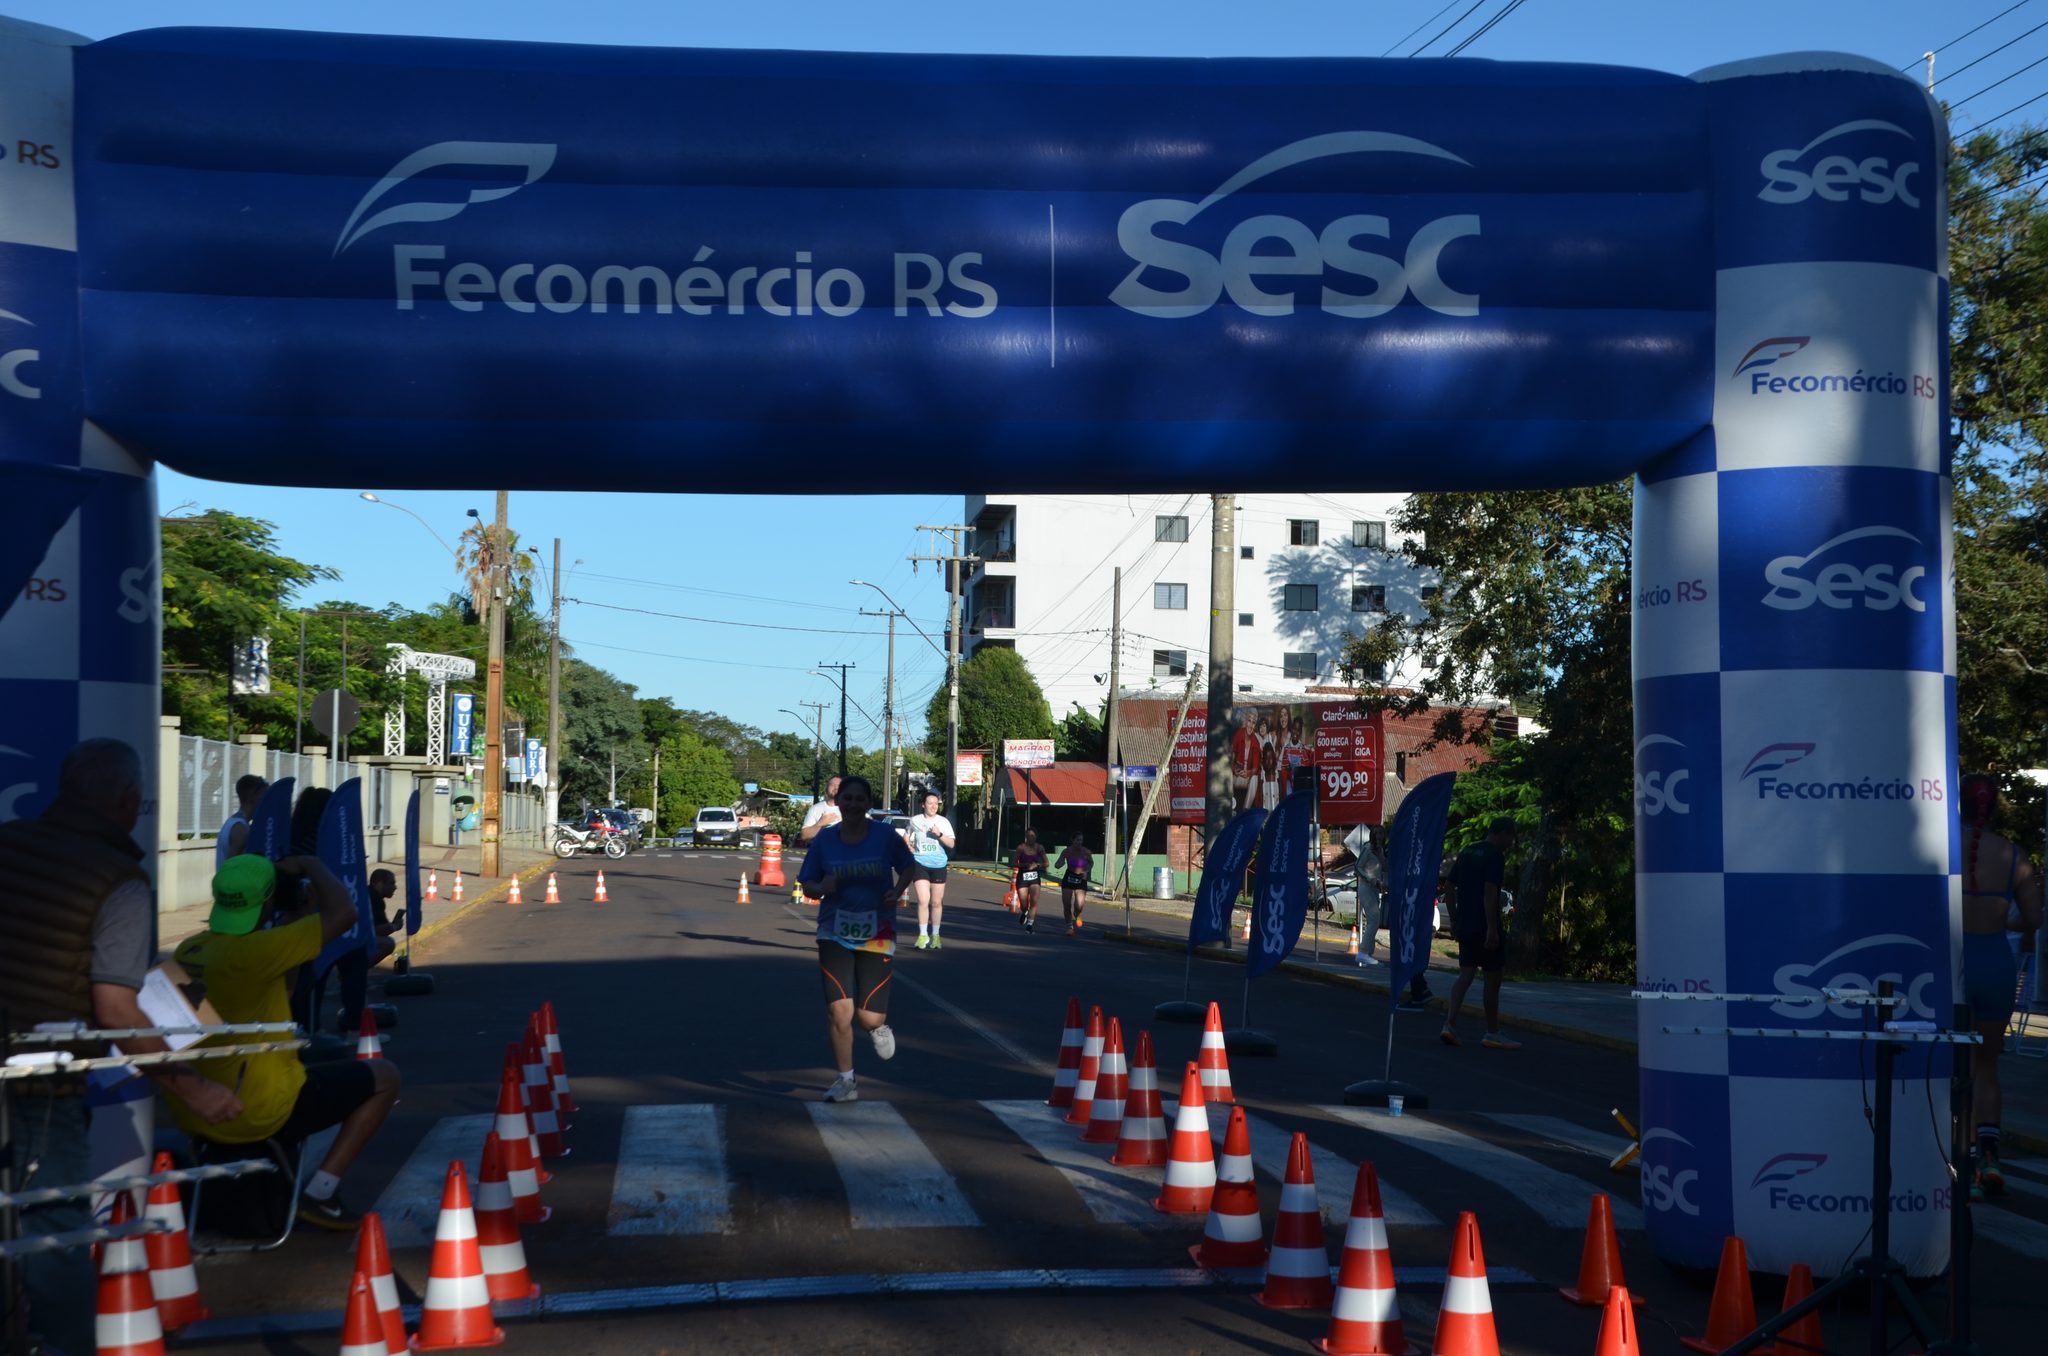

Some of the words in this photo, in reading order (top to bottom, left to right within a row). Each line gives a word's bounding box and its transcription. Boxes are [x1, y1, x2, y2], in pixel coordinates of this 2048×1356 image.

[18, 140, 60, 169] RS
[1757, 148, 1921, 209] Sesc
[1108, 197, 1482, 319] Sesc
[394, 244, 865, 318] Fecomércio
[894, 251, 998, 318] RS
[1751, 368, 1908, 395] Fecomércio
[1913, 374, 1936, 400] RS
[1677, 579, 1708, 603] RS
[1761, 555, 1926, 613] Sesc
[457, 713, 470, 752] URI
[1171, 715, 1206, 728] Fderico
[1189, 745, 1207, 757] Mult
[1317, 738, 1330, 747] 600
[1331, 737, 1349, 746] MEGA
[1354, 747, 1371, 756] GIGA
[1355, 736, 1364, 746] 60
[529, 751, 538, 777] URI
[1759, 776, 1915, 800] Fecomércio
[1920, 779, 1944, 802] RS
[922, 844, 937, 852] 509
[839, 921, 872, 938] 362
[1262, 883, 1286, 955] Sesc
[1770, 1186, 1927, 1214] Fecomrcio
